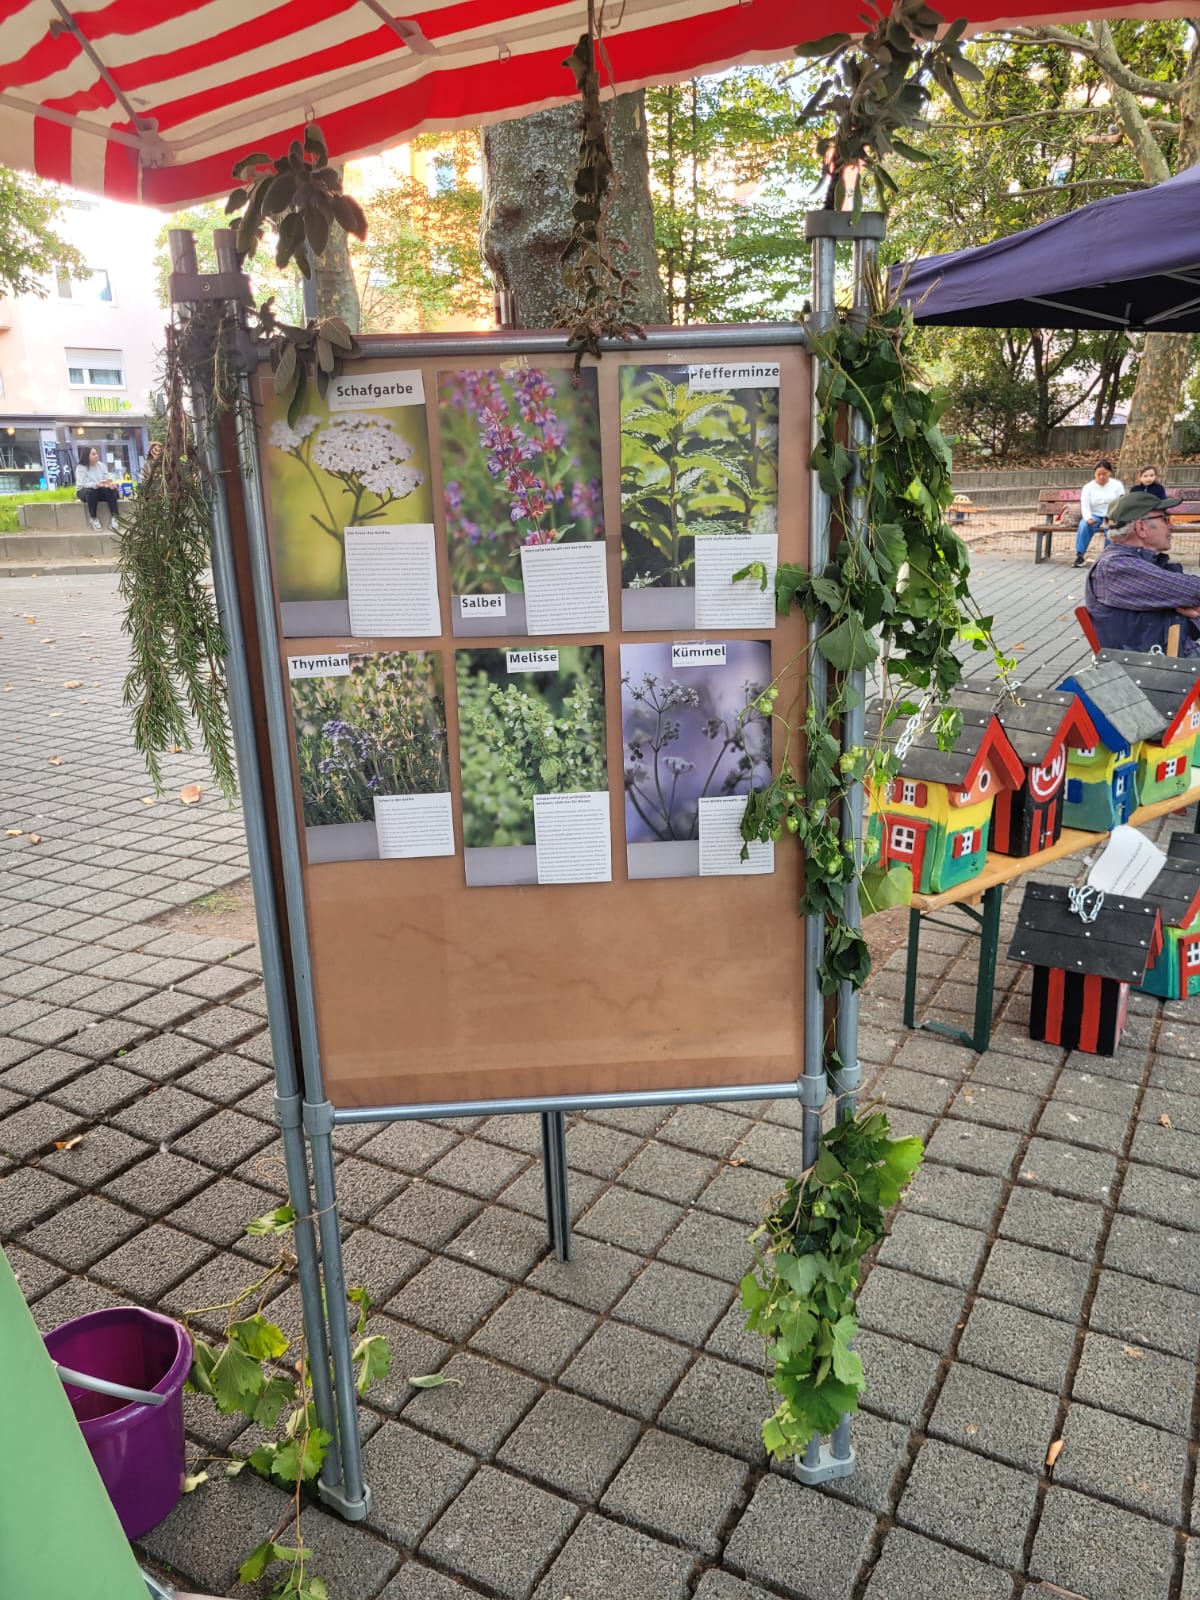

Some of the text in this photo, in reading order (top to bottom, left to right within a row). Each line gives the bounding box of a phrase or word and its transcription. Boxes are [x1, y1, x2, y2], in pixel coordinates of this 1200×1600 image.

[336, 382, 413, 398] Schafgarbe
[462, 596, 502, 608] Salbei
[509, 652, 557, 663] Melisse
[673, 645, 726, 658] Kümmel
[291, 656, 349, 671] Thymian
